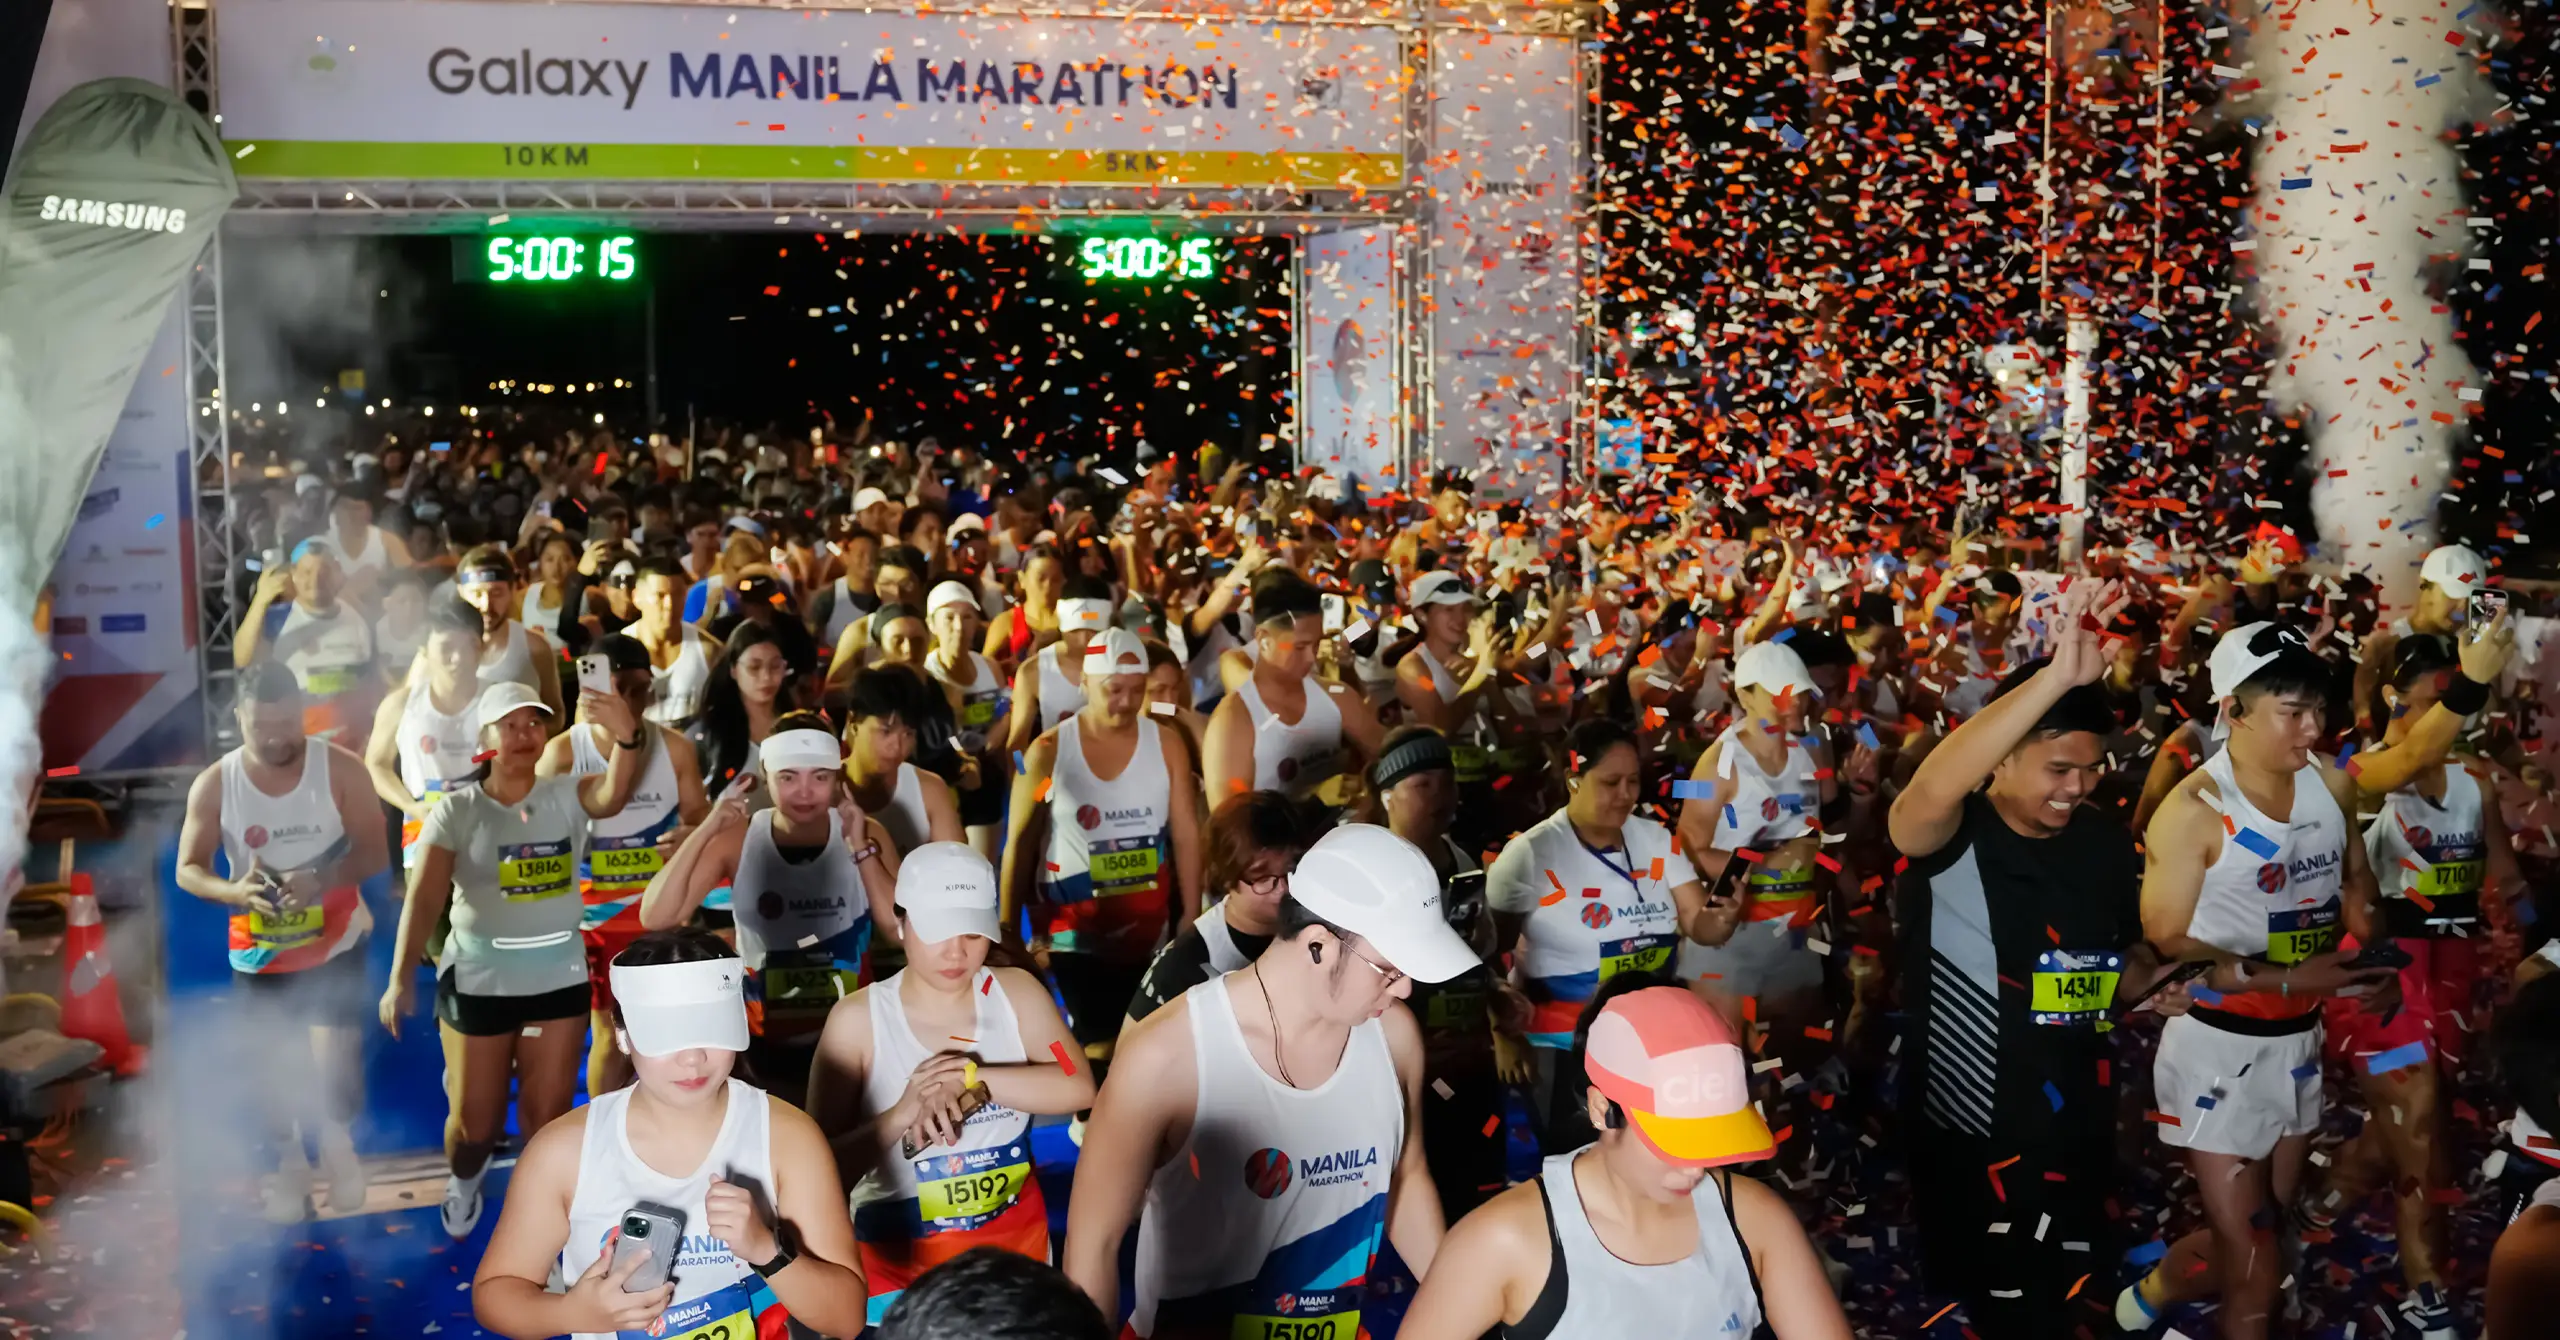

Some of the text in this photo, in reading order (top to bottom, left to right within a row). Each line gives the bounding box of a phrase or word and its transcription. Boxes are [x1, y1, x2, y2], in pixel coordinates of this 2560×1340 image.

[428, 47, 1237, 110] Galaxy MANILA MARATHON
[40, 194, 186, 234] SAMSUNG
[1105, 806, 1153, 821] MANILA
[605, 851, 652, 868] 16236
[1102, 852, 1148, 871] 15088
[2289, 850, 2341, 879] MANILA
[517, 860, 562, 879] 13816
[945, 883, 978, 891] KIPRUN
[788, 896, 847, 911] MANILA
[1423, 895, 1441, 908] KIPR
[1617, 902, 1669, 918] MANILA
[2290, 930, 2332, 954] 1512
[2054, 976, 2101, 999] 14341
[1662, 1062, 1733, 1107] ciel
[963, 1109, 1015, 1126] MARATHON
[965, 1151, 1000, 1164] MANILA
[1300, 1146, 1377, 1180] MANILA
[1308, 1170, 1364, 1188] MARATHON
[943, 1172, 1009, 1205] 15192
[680, 1235, 730, 1254] ANIL
[672, 1255, 734, 1267] MARATHON
[1299, 1295, 1335, 1306] MANILA
[668, 1302, 712, 1325] MANILA
[677, 1313, 707, 1328] MARATHON
